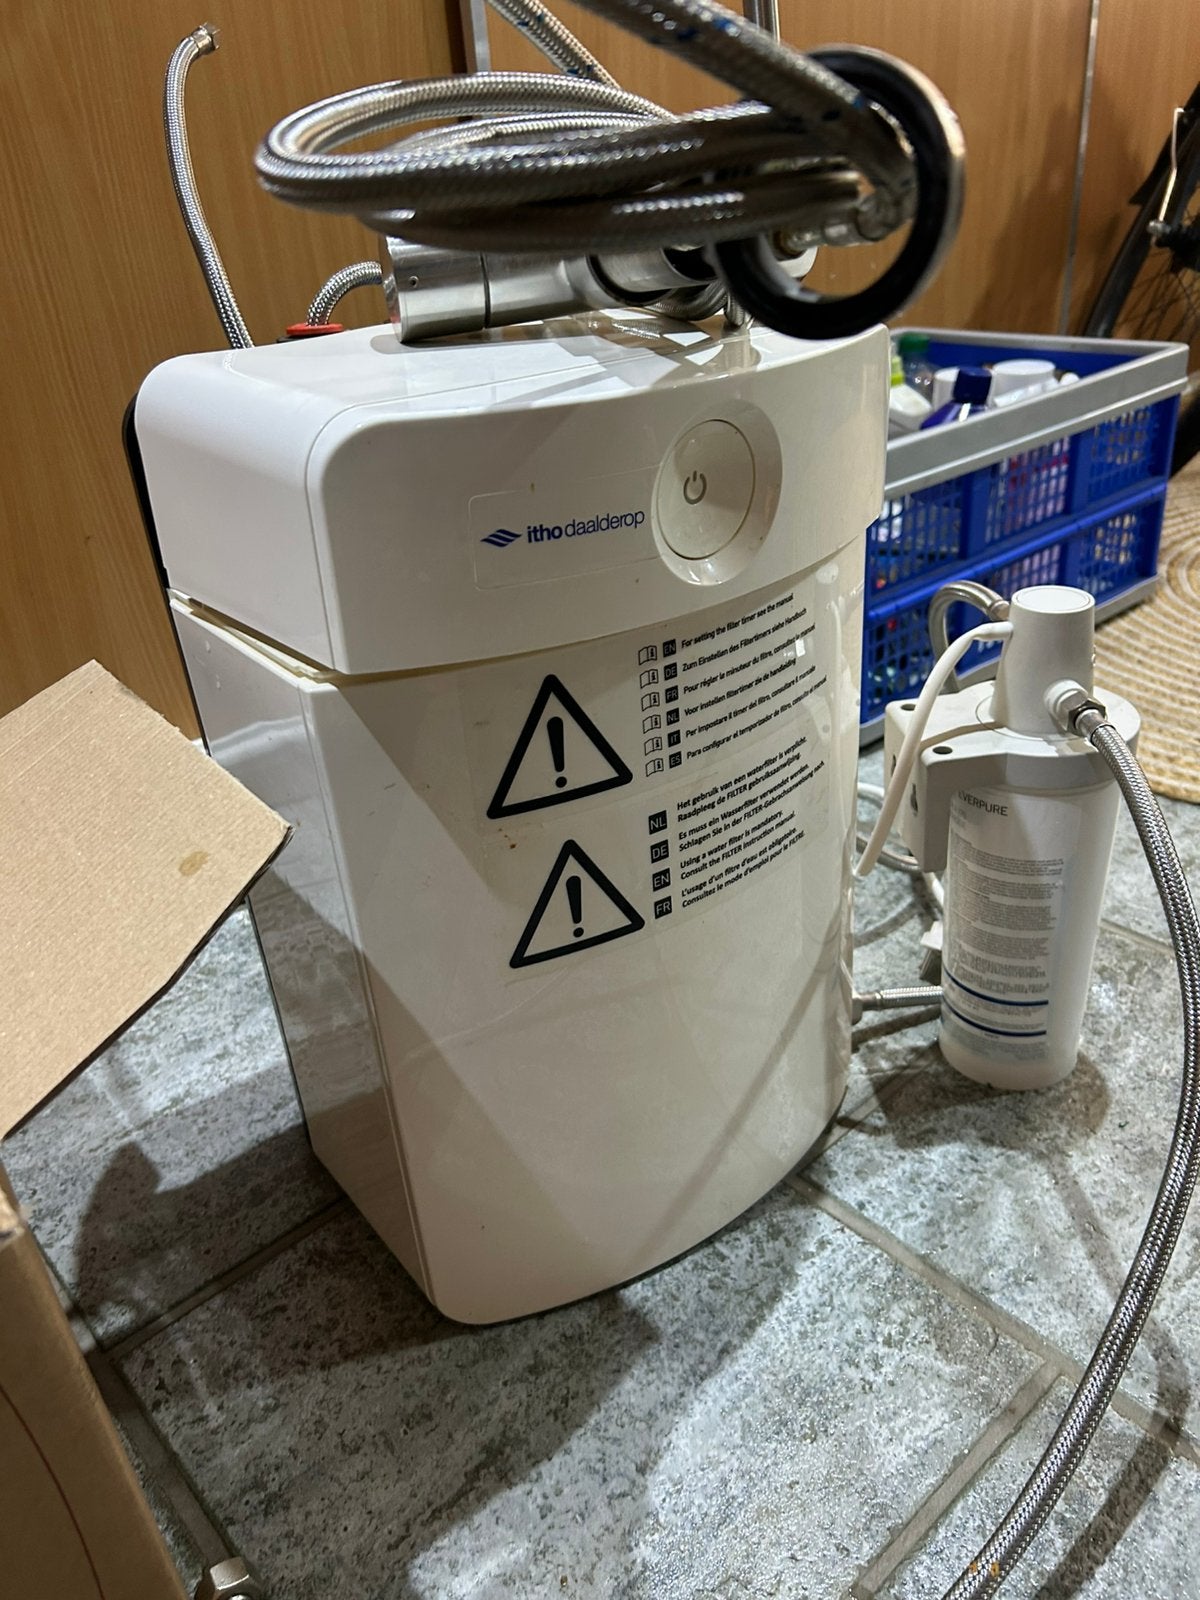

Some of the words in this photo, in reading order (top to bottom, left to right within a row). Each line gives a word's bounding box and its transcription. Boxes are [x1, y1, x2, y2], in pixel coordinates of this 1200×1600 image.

[664, 641, 675, 655] EN
[681, 639, 693, 649] For
[694, 630, 715, 644] setting
[716, 626, 726, 635] the
[727, 619, 740, 631] filter
[741, 613, 756, 625] timer
[757, 609, 766, 618] see
[767, 604, 775, 613] the
[776, 593, 793, 608] manual
[665, 665, 677, 679] DE
[682, 661, 697, 671] Zum
[698, 649, 728, 666] Einstellen
[729, 644, 739, 653] des
[740, 629, 771, 648] Filtertimers
[772, 621, 784, 633] siehe
[785, 607, 806, 625] Handbuch
[666, 687, 678, 702] FR
[683, 683, 699, 694] Pour
[700, 675, 719, 687] régler
[719, 672, 725, 680] le
[726, 660, 751, 677] minuteur
[667, 710, 679, 724] NL
[684, 706, 699, 716] Voor
[700, 695, 726, 710] instellen
[763, 673, 769, 681] de
[669, 732, 680, 745] IT
[686, 728, 697, 738] Per
[698, 716, 727, 733] impostare
[733, 706, 748, 717] timer
[749, 700, 757, 710] del
[670, 754, 681, 767] ES
[687, 749, 701, 759] Para
[702, 735, 732, 752] configurar
[733, 730, 739, 738] el
[677, 799, 691, 811] Het
[692, 786, 719, 806] gebruik
[720, 781, 732, 792] van
[734, 774, 746, 785] een
[747, 755, 778, 777] waterfilter
[779, 752, 783, 760] is
[649, 814, 666, 832] NL
[678, 801, 716, 823] Raadpleeg
[717, 796, 726, 805] de
[727, 784, 747, 800] FILTER
[679, 832, 687, 840] Es
[689, 823, 707, 836] muss
[708, 817, 719, 827] ein
[721, 796, 758, 821] Wasserfilter
[651, 842, 668, 862] DE
[679, 833, 711, 852] Schlagen
[712, 827, 723, 837] Sie
[724, 823, 731, 831] in
[731, 816, 742, 827] der
[680, 855, 700, 869] Using
[707, 842, 727, 856] water
[728, 833, 744, 846] filter
[745, 829, 750, 837] is
[681, 863, 708, 880] Consult
[709, 857, 720, 868] the
[722, 844, 742, 861] FILTER
[743, 826, 774, 849] instruction
[653, 871, 670, 889] EN
[681, 881, 707, 897] L'usage
[708, 872, 724, 885] d'un
[724, 864, 740, 876] filtre
[741, 853, 758, 867] d'eau
[759, 846, 768, 857] est
[682, 887, 716, 908] Consultez
[716, 883, 724, 891] le
[724, 873, 743, 887] mode
[770, 847, 783, 862] pour
[783, 843, 788, 851] le
[655, 899, 671, 917] FR
